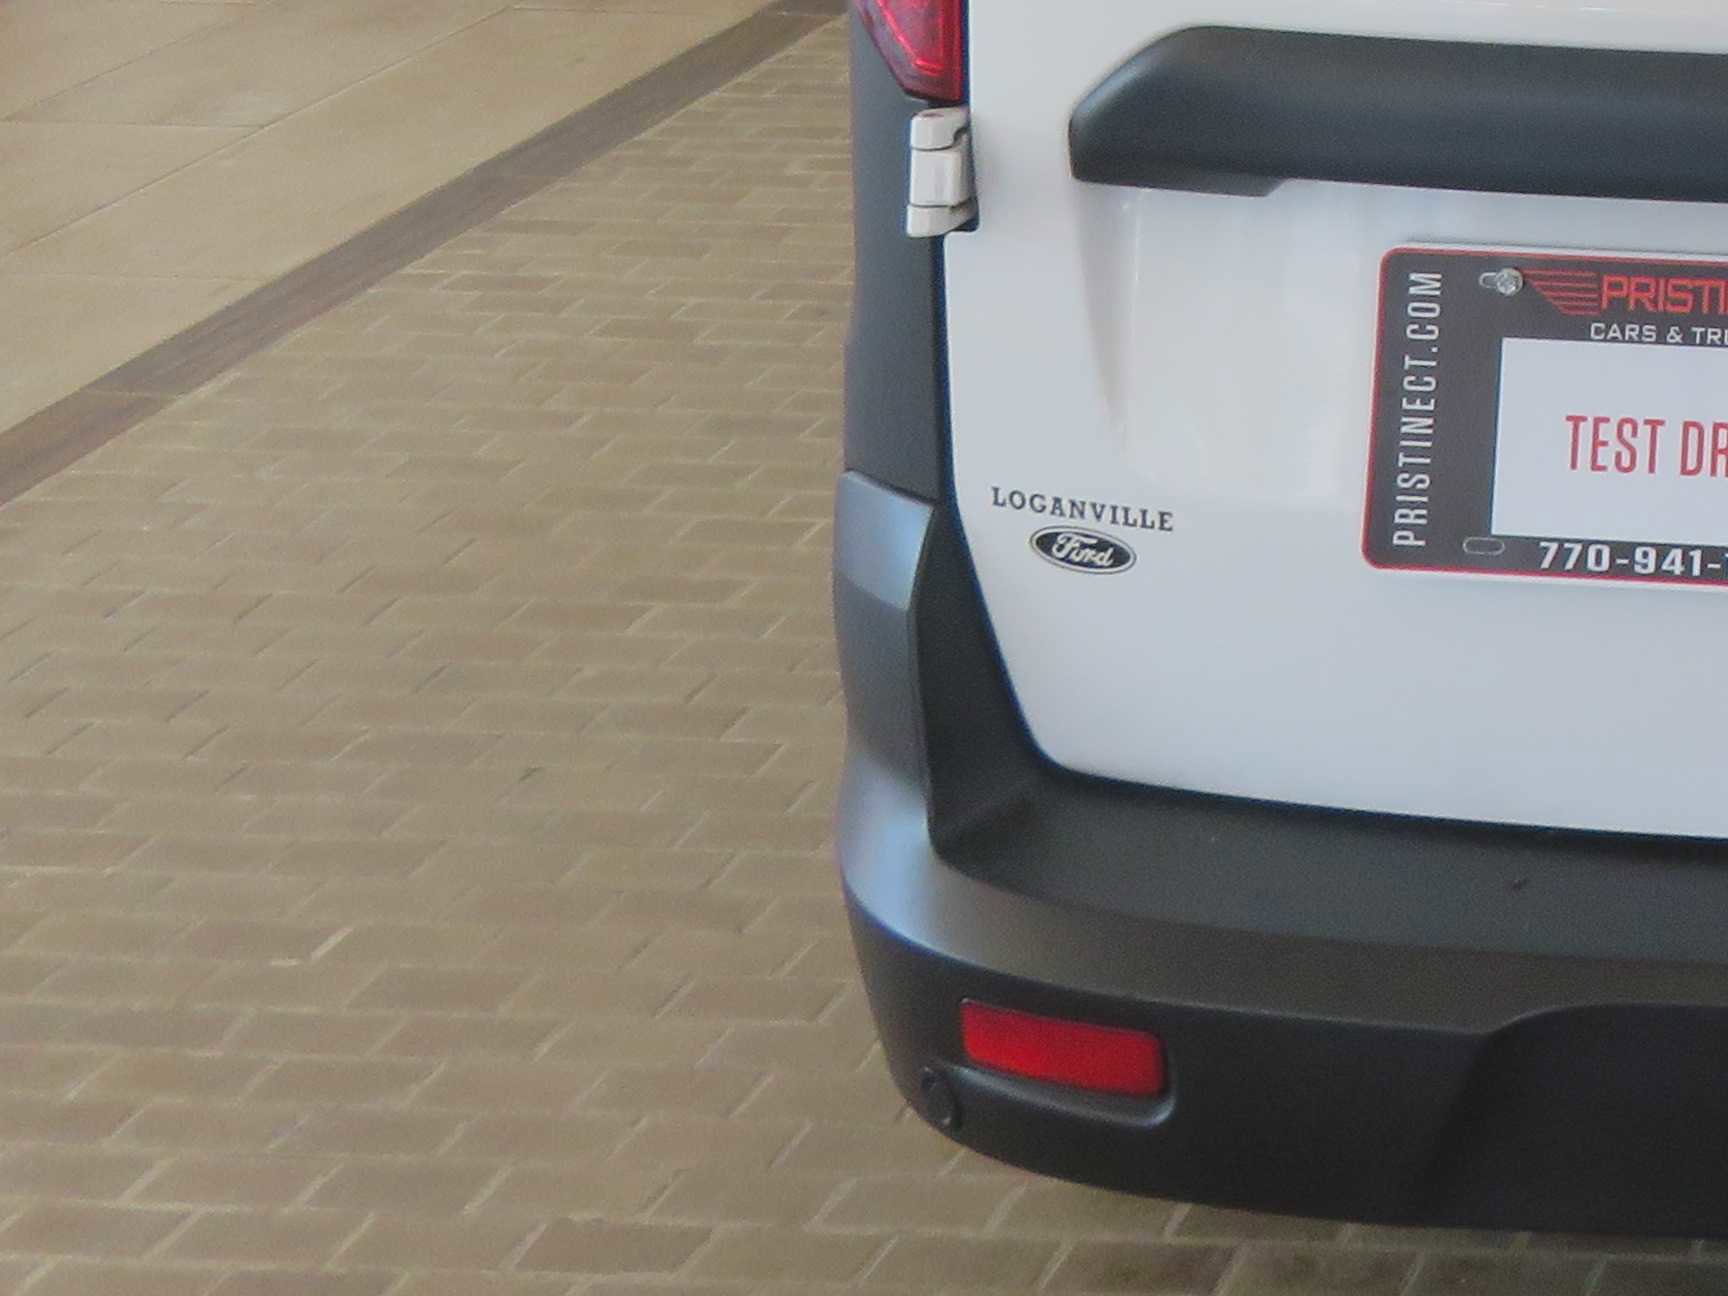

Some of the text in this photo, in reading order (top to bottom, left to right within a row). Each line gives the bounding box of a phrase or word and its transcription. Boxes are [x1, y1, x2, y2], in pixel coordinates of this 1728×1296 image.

[1589, 322, 1658, 343] CARS
[1666, 325, 1683, 343] &
[1392, 270, 1443, 548] PRISTINECT.COM
[1564, 414, 1667, 476] TEST
[991, 486, 1174, 532] LOGANVILLE
